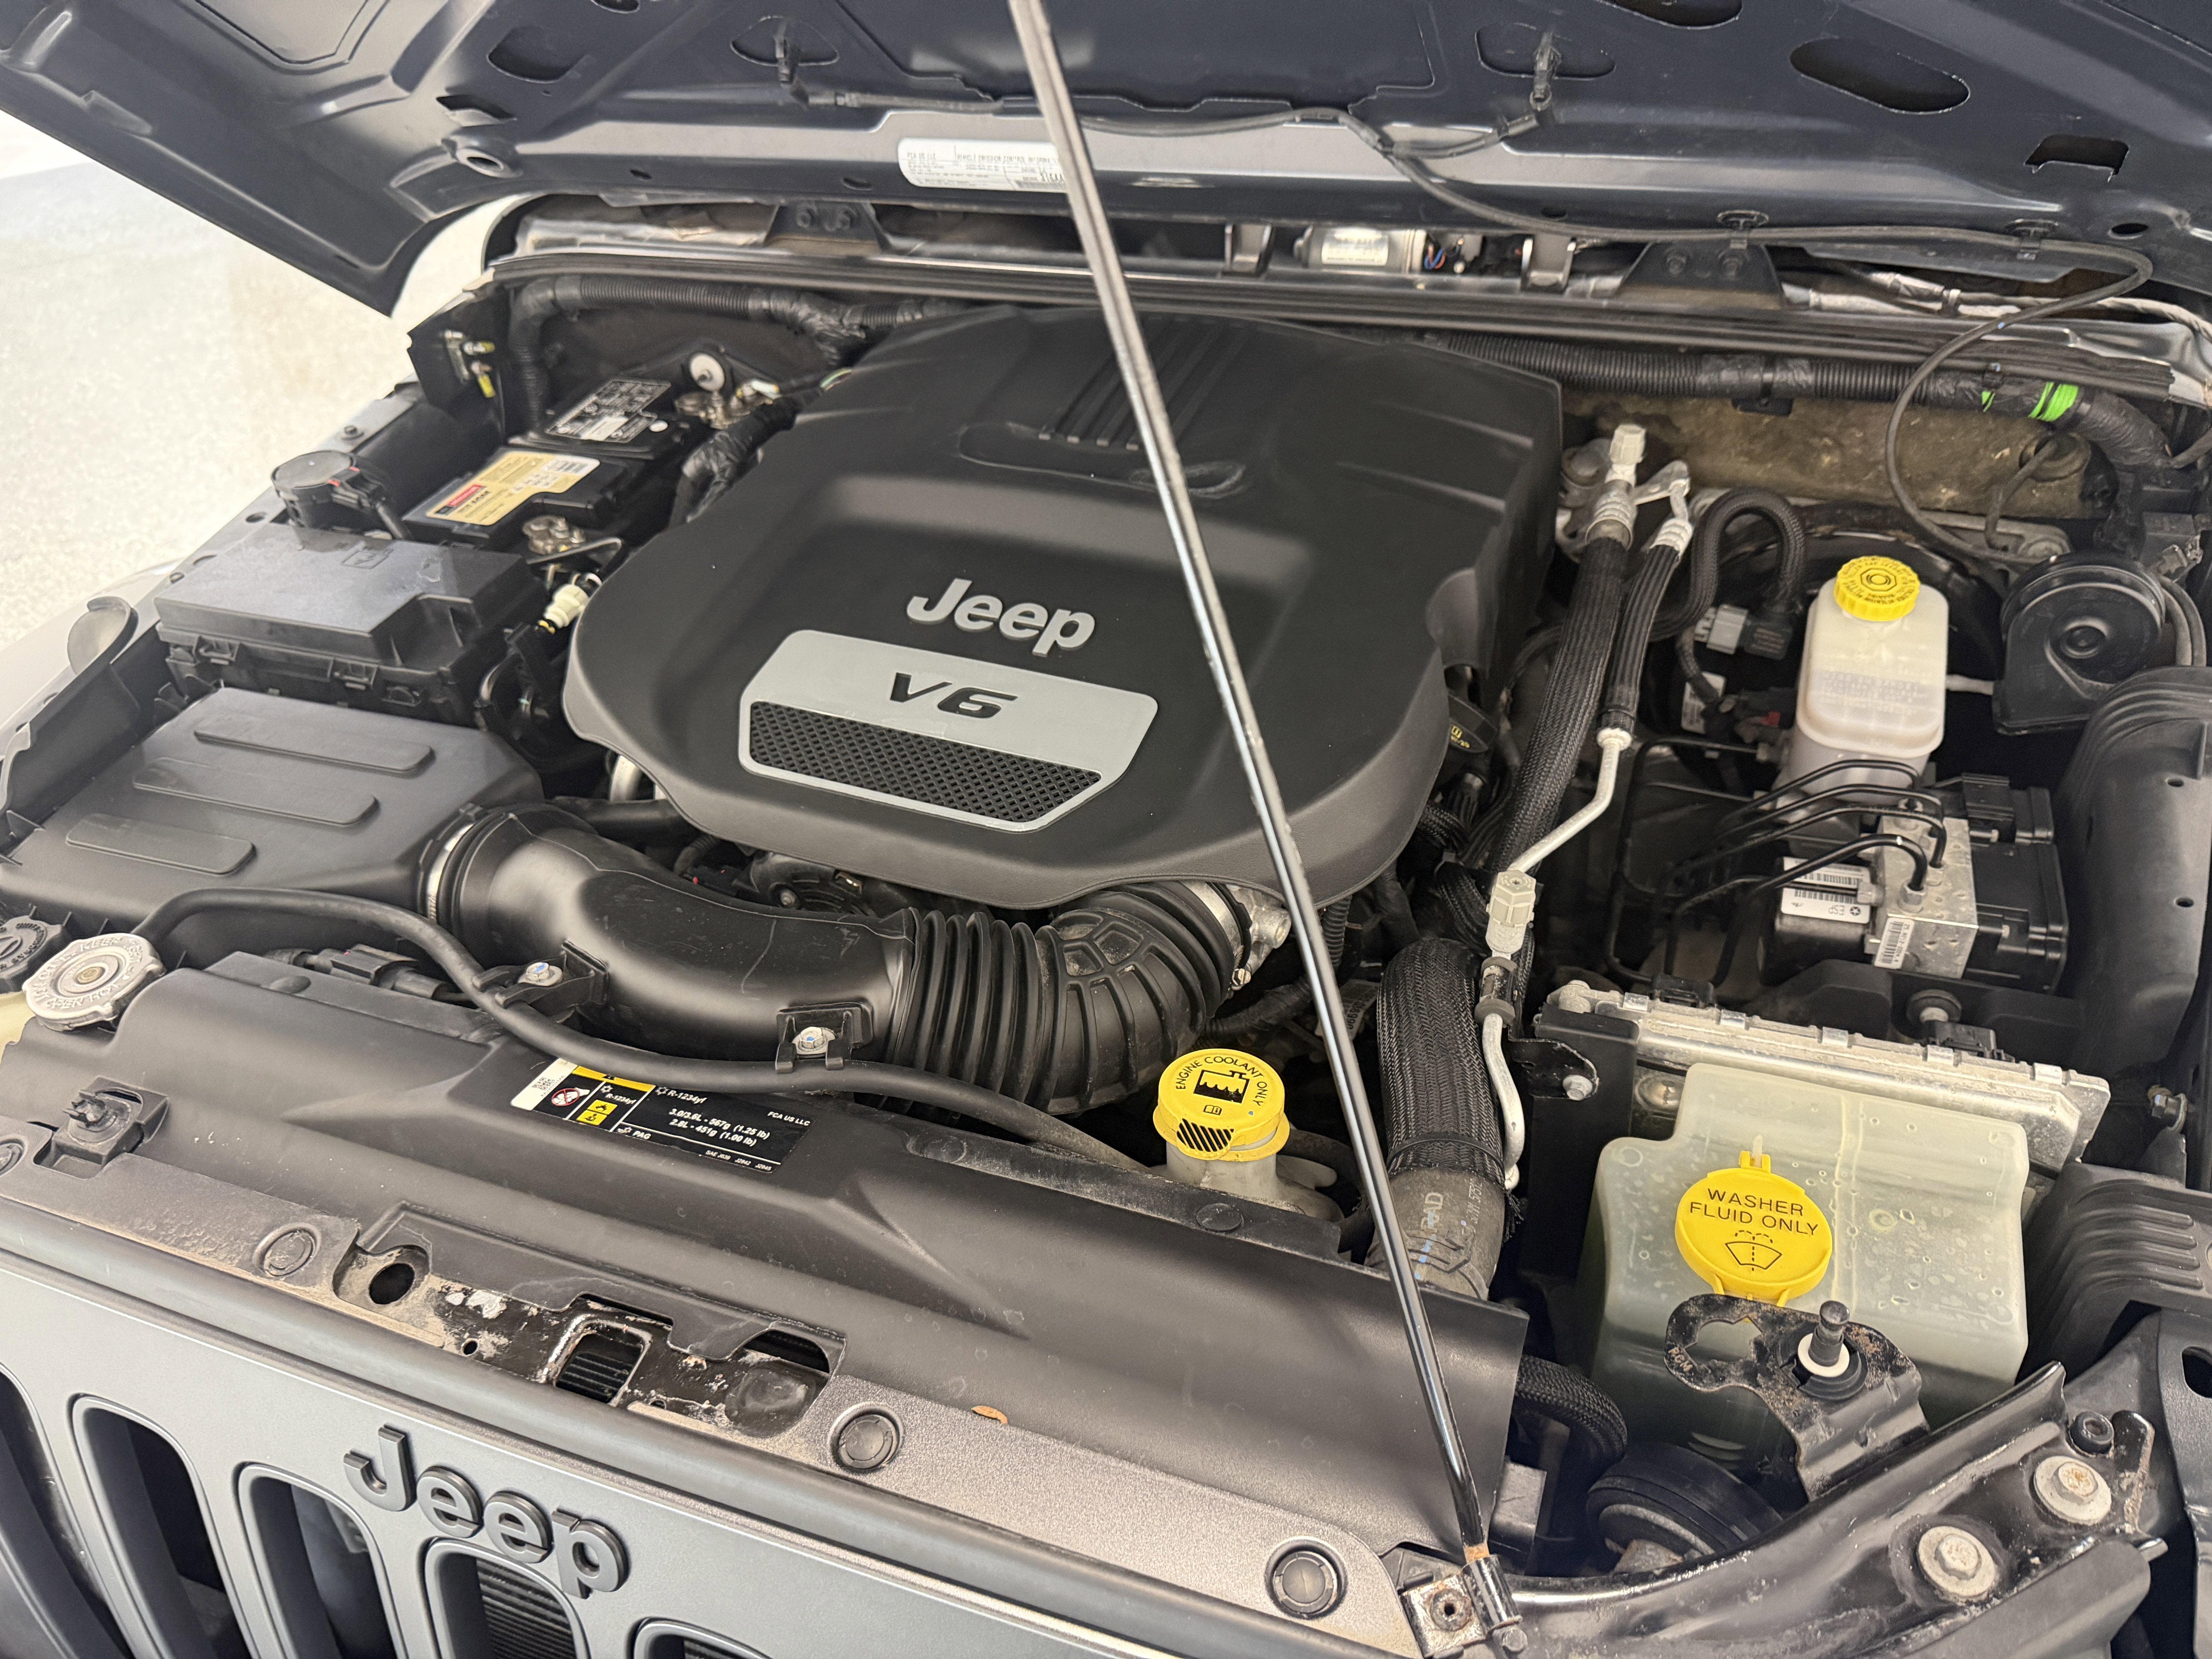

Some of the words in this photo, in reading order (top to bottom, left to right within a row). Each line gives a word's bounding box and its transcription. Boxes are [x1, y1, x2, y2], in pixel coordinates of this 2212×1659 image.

[906, 578, 1096, 657] Jeep
[890, 672, 1018, 719] V6
[1829, 905, 1844, 916] ESP
[80, 937, 123, 952] KEEP
[46, 997, 85, 1009] OPEN
[89, 984, 118, 1002] HOT
[1176, 1060, 1202, 1089] ENGINE
[1204, 1056, 1265, 1078] COOLANT
[1253, 1081, 1268, 1106] ONLY
[667, 1089, 707, 1104] R-1234yf
[668, 1108, 702, 1123] 3.0/3.6L
[709, 1118, 731, 1131] 567g
[733, 1124, 756, 1135] (1.25
[757, 1130, 771, 1140] lb)
[669, 1119, 688, 1129] 2.8L
[695, 1125, 718, 1137] 451g
[719, 1131, 742, 1143] (1.00
[743, 1137, 757, 1147] lb)
[767, 1111, 783, 1120] FCA
[783, 1114, 795, 1122] US
[795, 1118, 811, 1127] LLC
[632, 1130, 652, 1140] PAG
[1707, 1188, 1803, 1216] WASHER
[1690, 1201, 1753, 1224] FLUID
[1762, 1215, 1819, 1235] ONLY
[343, 1423, 630, 1599] Jeep
